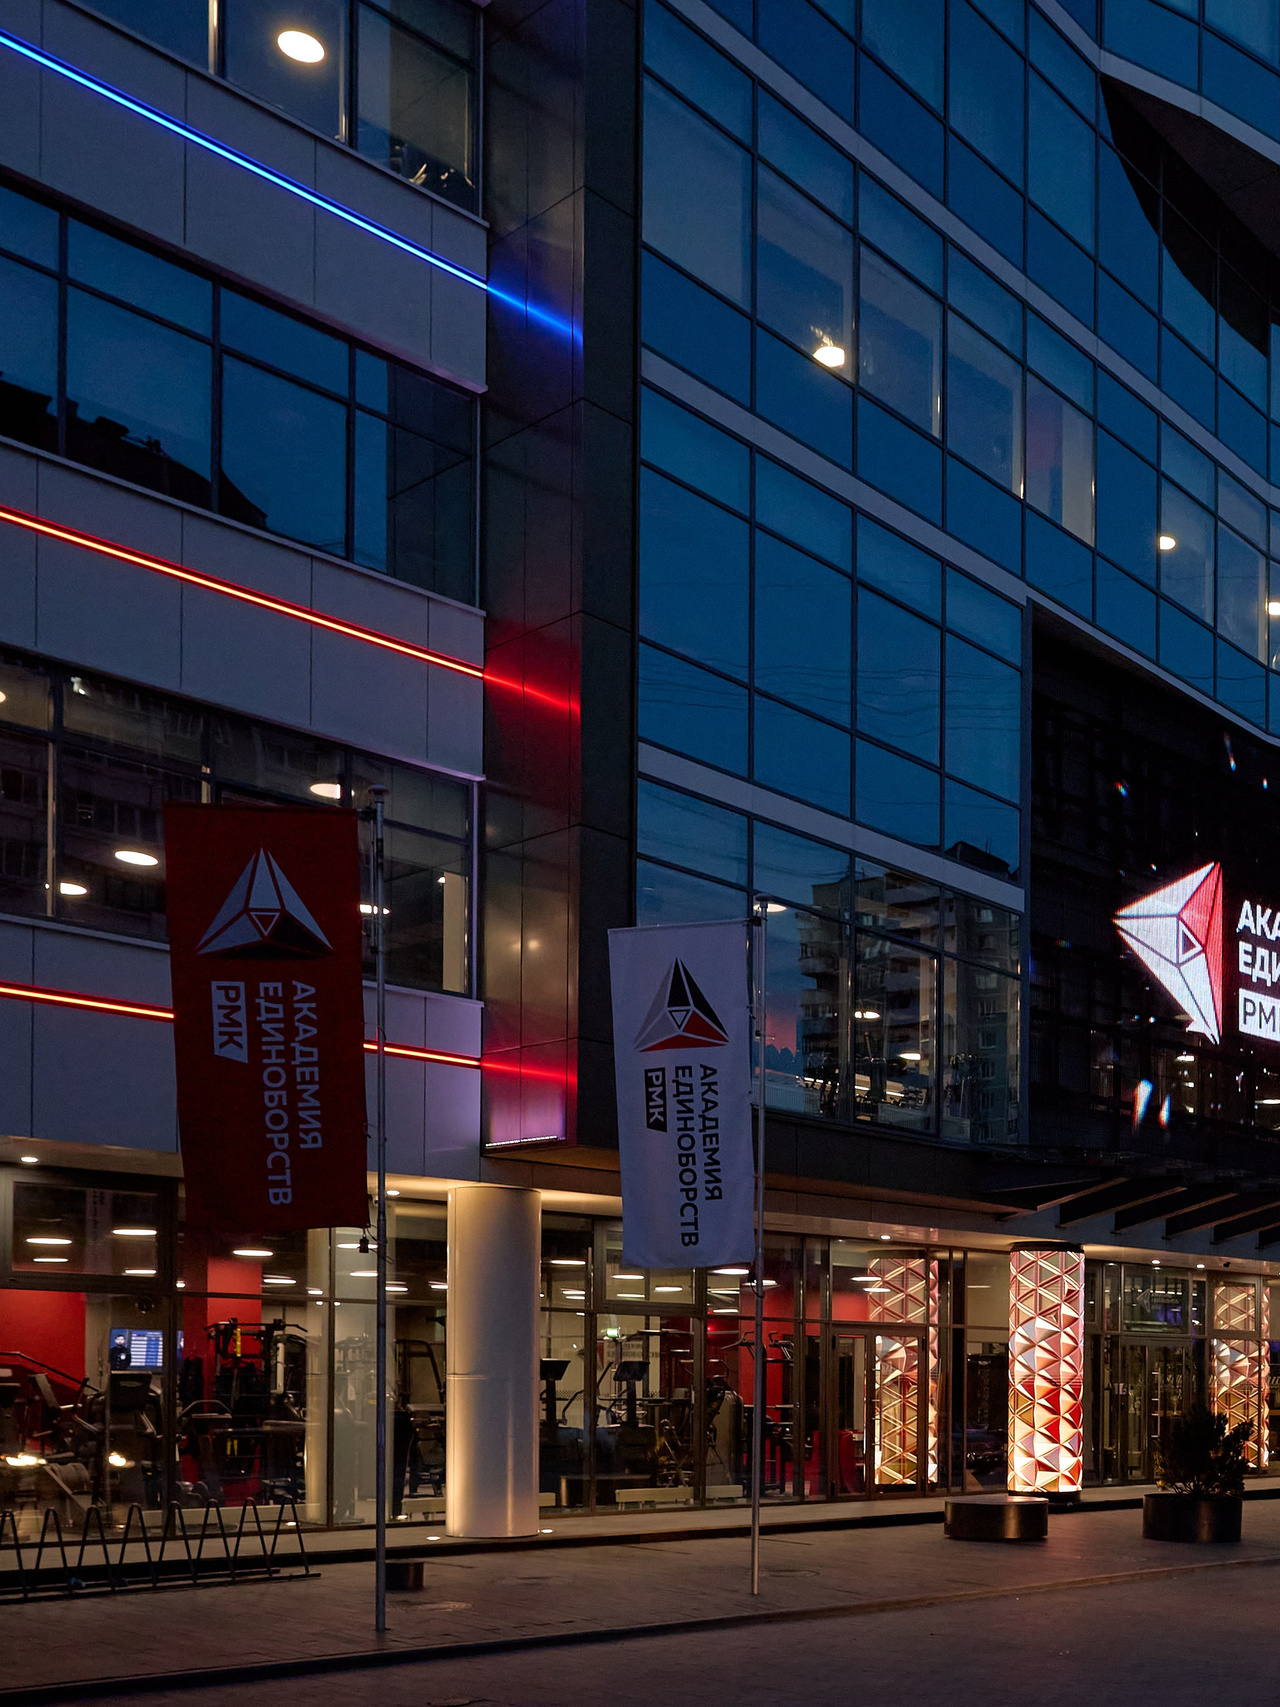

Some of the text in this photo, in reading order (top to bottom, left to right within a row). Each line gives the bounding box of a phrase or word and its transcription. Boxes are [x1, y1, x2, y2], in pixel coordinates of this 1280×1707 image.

[214, 986, 245, 1051] РМК
[256, 981, 292, 1205] ЕДИНОБОРСТВ
[292, 980, 323, 1150] АКАДЕМИЯ
[646, 1071, 666, 1125] РМК
[675, 1065, 699, 1247] ЕДИНОБОРСТВ
[699, 1063, 723, 1201] АКАДЕМИЯ
